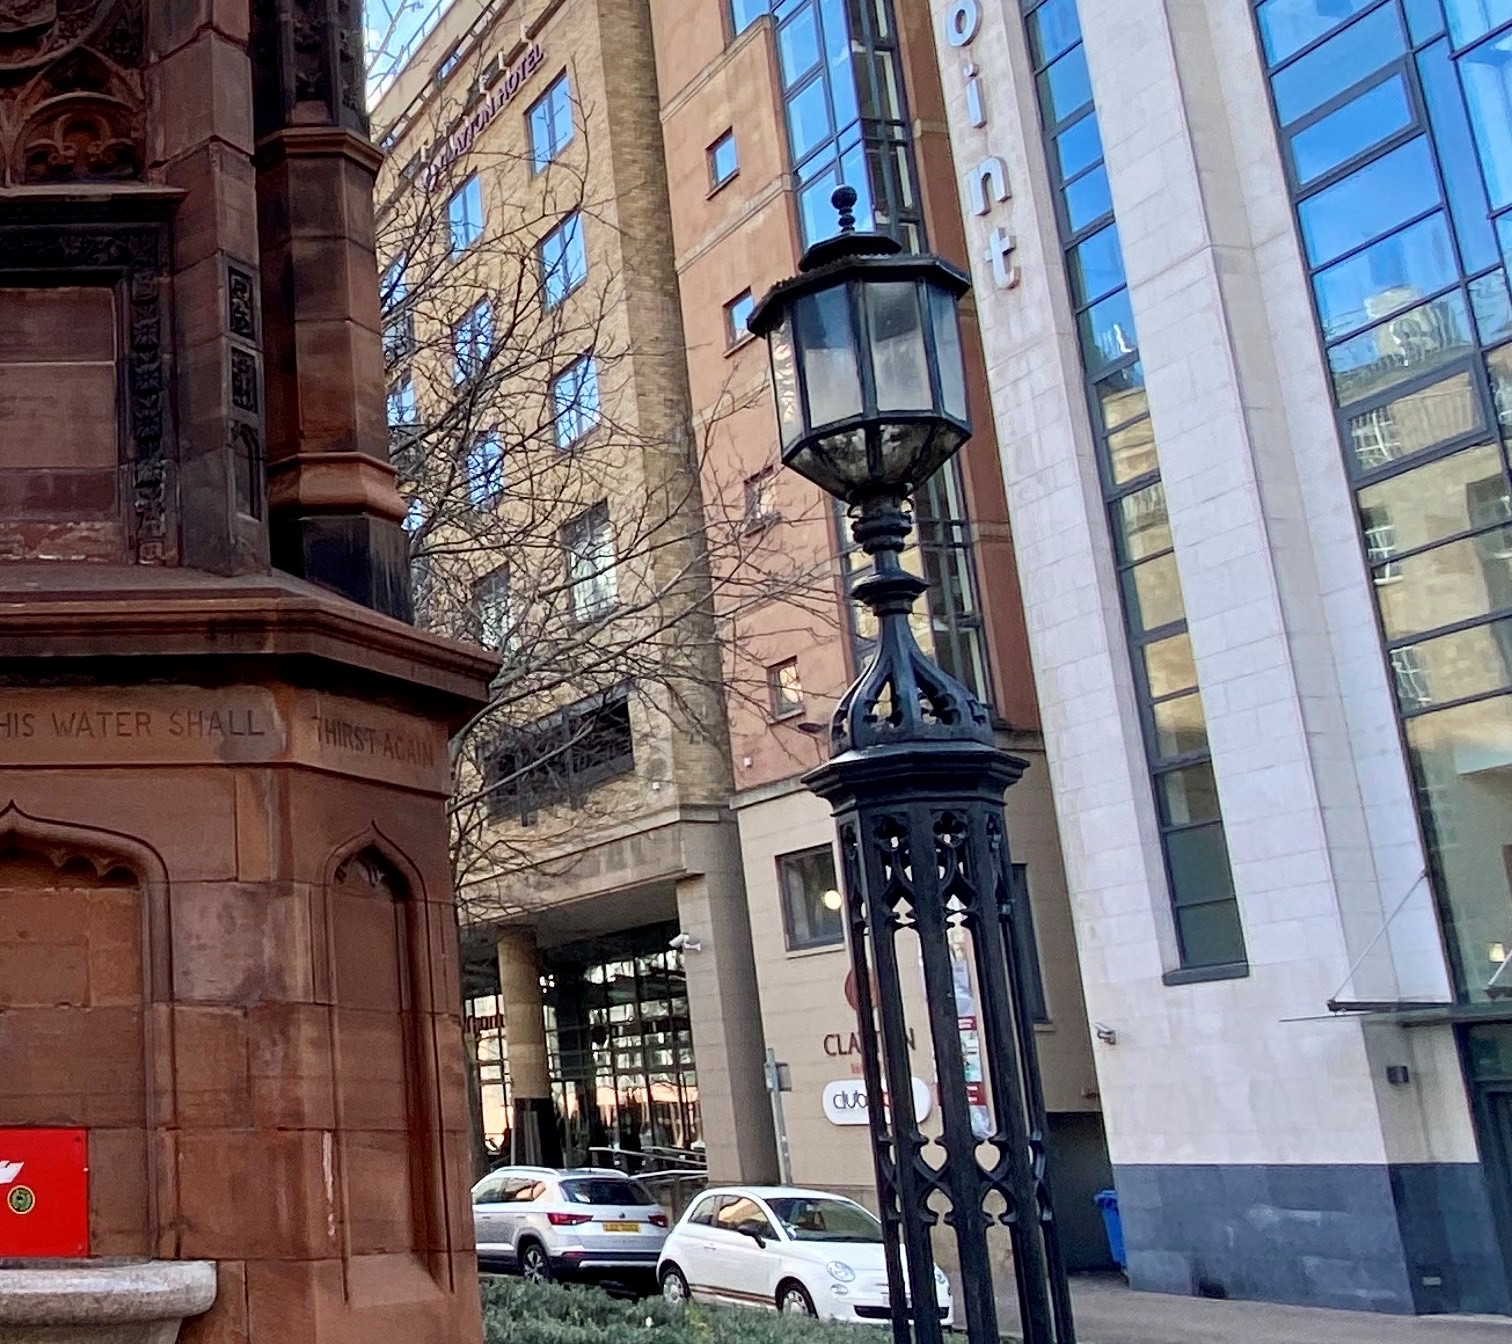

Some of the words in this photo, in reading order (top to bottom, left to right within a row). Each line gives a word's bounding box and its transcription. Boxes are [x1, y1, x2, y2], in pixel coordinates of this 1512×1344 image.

[498, 44, 544, 107] HOTEL
[51, 711, 151, 738] WATER
[168, 709, 266, 737] SHALL
[312, 716, 376, 754] THIRST
[383, 733, 434, 768] AGAIN
[823, 1027, 916, 1056] CLAN
